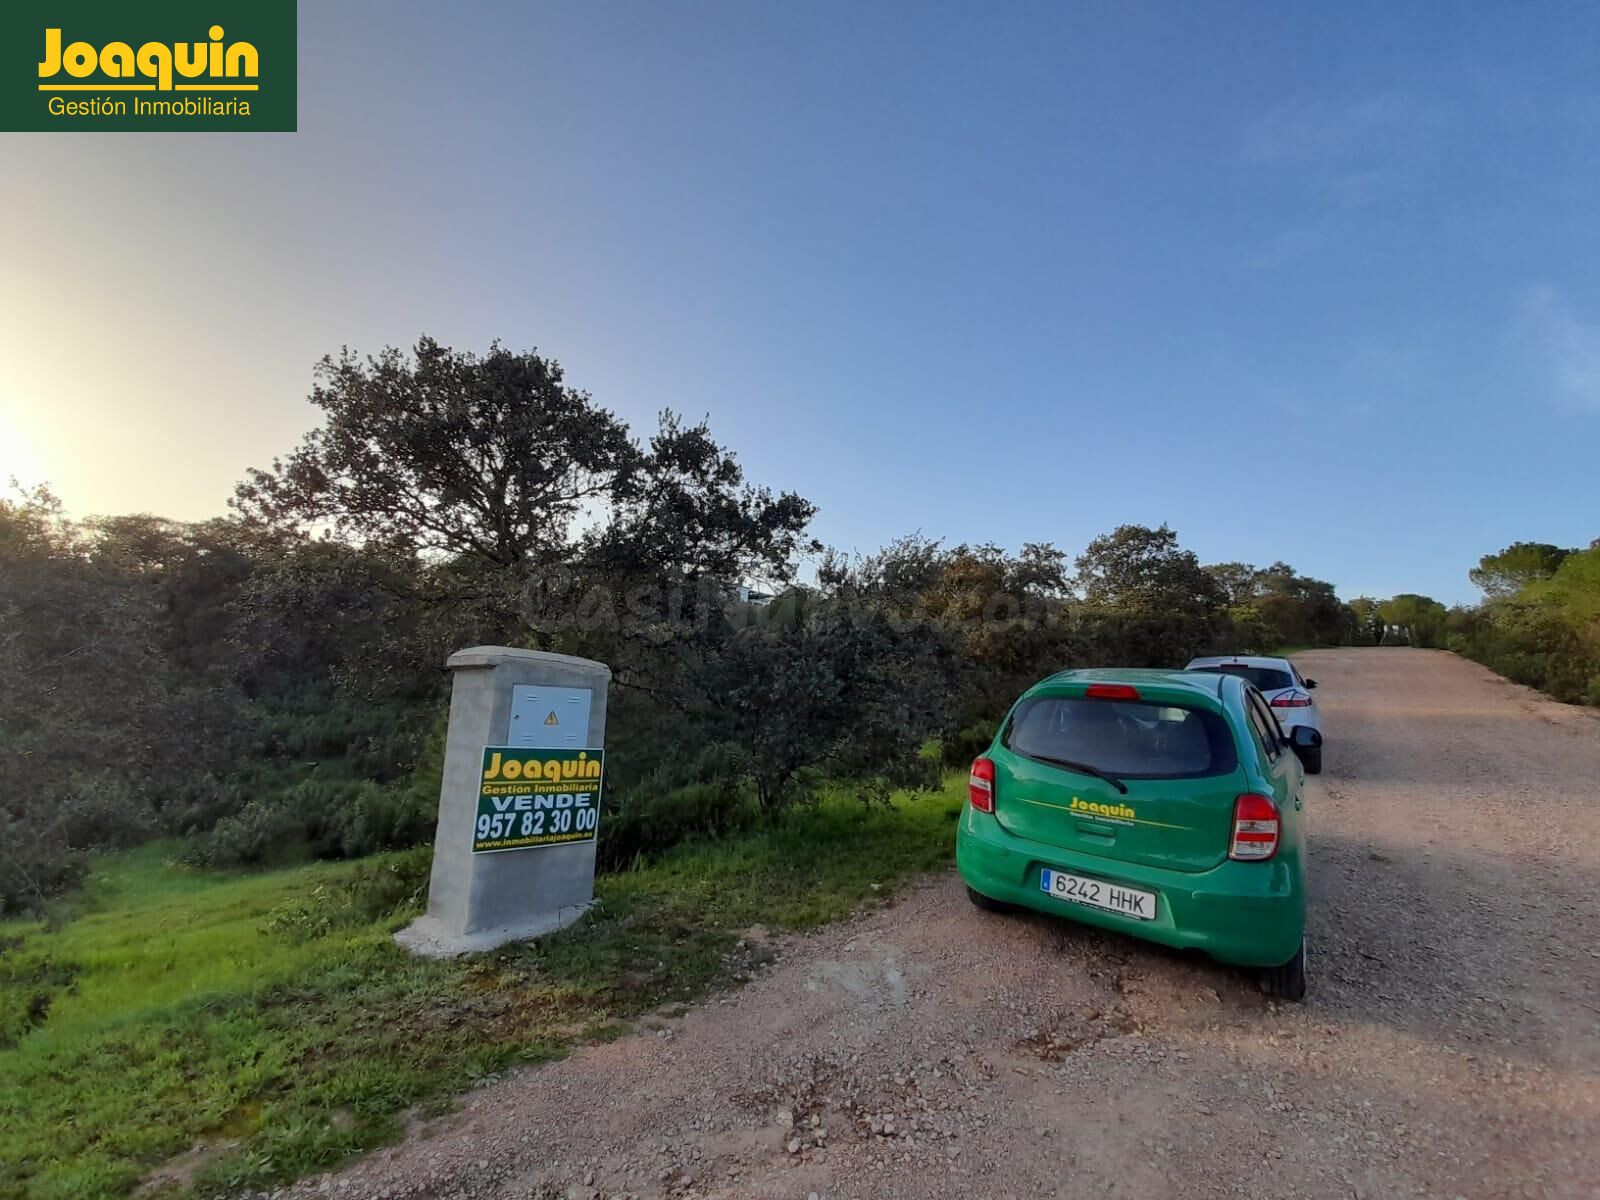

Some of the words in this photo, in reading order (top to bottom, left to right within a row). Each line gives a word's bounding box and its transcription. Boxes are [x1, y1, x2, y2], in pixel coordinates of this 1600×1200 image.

[484, 752, 600, 783] Joaquin
[534, 784, 598, 793] Inmobiliaria
[491, 793, 591, 811] VENDE
[1069, 796, 1135, 818] Joaquin
[477, 812, 517, 840] 957
[521, 811, 545, 836] 82
[549, 809, 571, 833] 30
[575, 808, 596, 831] 00
[1056, 875, 1101, 902] 6242
[1109, 888, 1145, 914] HHK
